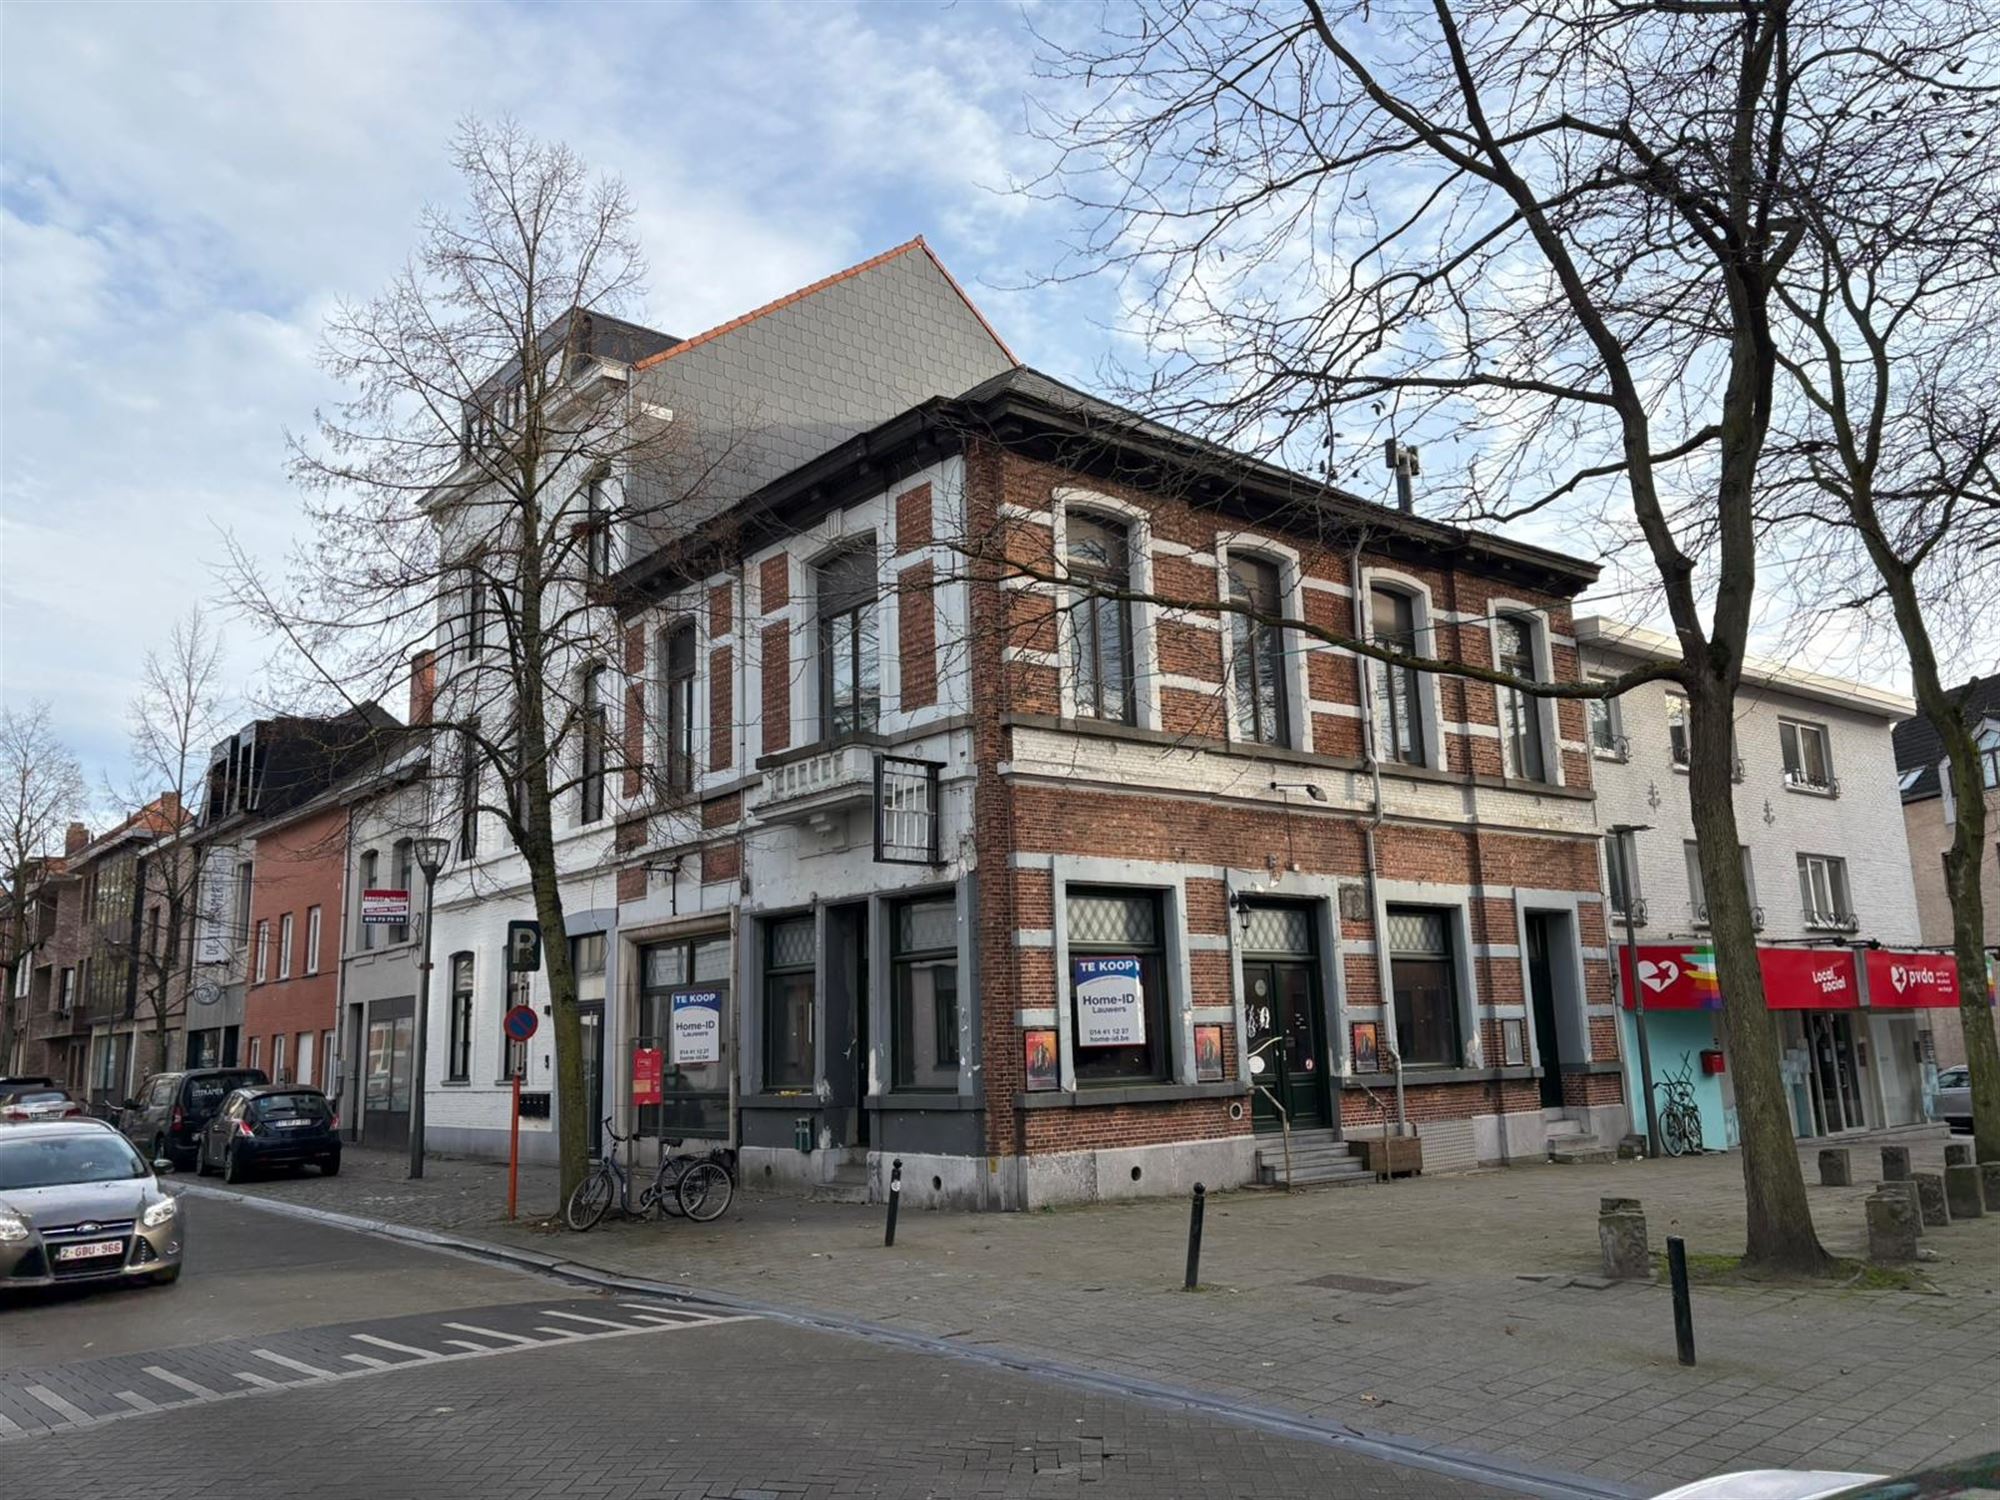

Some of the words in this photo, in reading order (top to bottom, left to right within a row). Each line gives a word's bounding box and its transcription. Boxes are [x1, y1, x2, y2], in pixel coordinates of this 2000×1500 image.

[513, 928, 537, 964] P
[1080, 962, 1095, 972] TE
[1099, 960, 1133, 971] KOOP
[1909, 967, 1935, 987] pvda
[1822, 975, 1847, 993] social
[675, 995, 687, 1004] TE
[689, 993, 716, 1003] KOOP
[1082, 993, 1135, 1006] Home-ID
[1092, 1006, 1126, 1014] Lauwers
[676, 1020, 715, 1031] Home-ID
